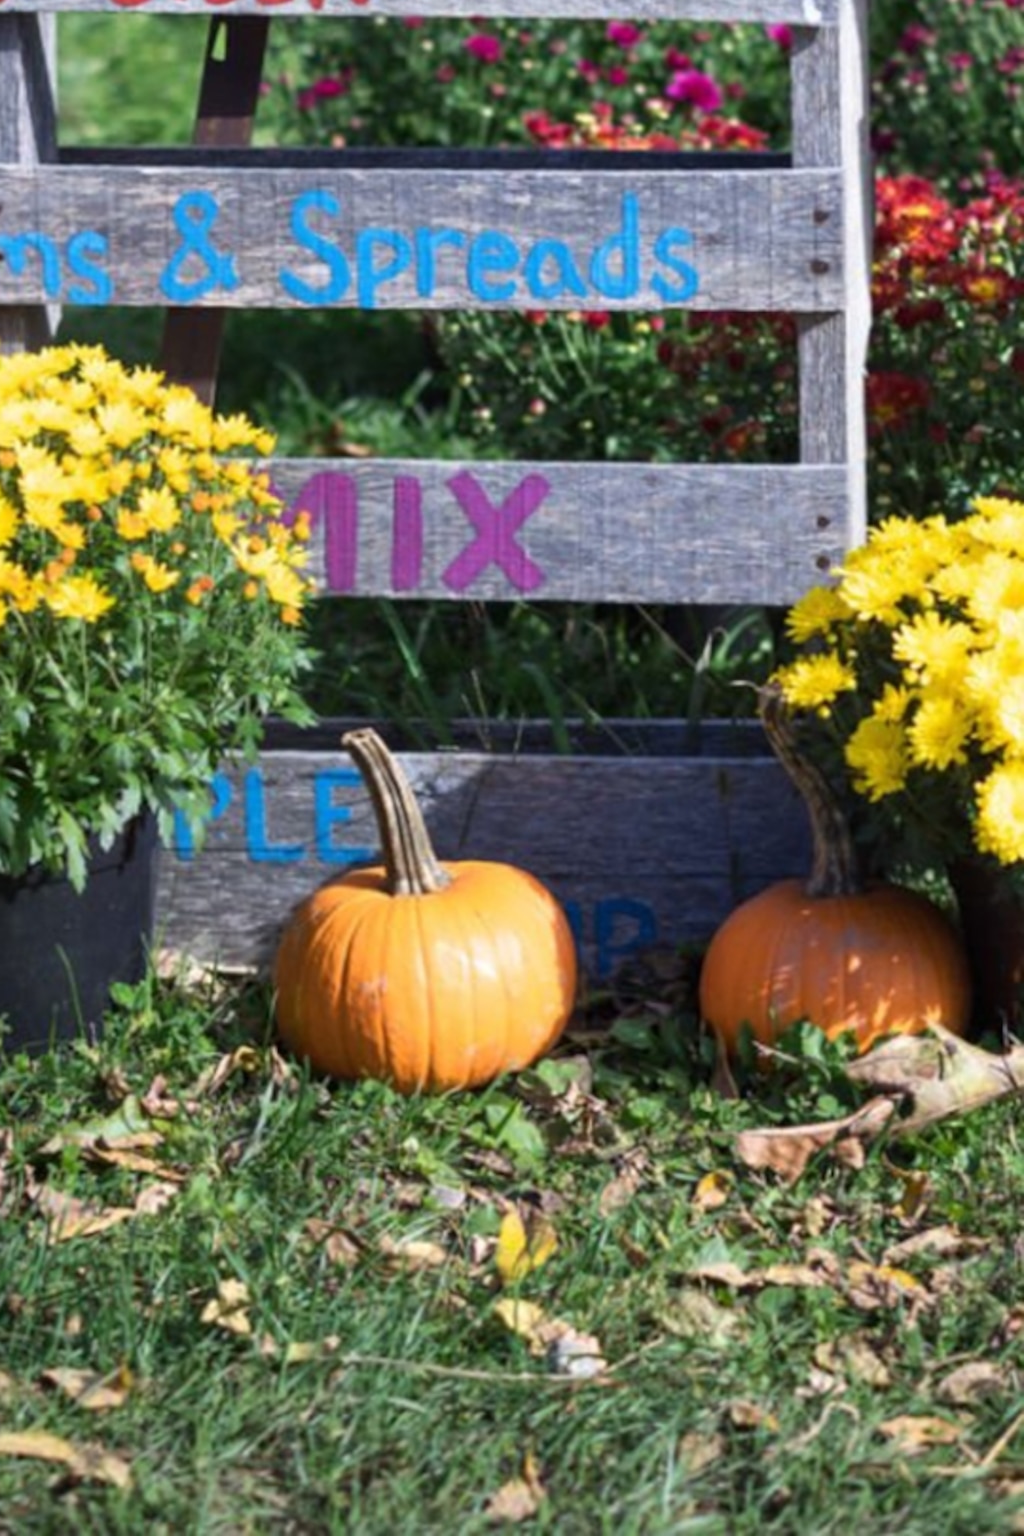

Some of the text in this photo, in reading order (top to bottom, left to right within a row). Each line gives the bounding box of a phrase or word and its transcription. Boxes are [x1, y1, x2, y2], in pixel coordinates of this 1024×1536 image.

[160, 189, 238, 303] &
[279, 189, 700, 310] Spreads
[172, 766, 381, 864] PLE
